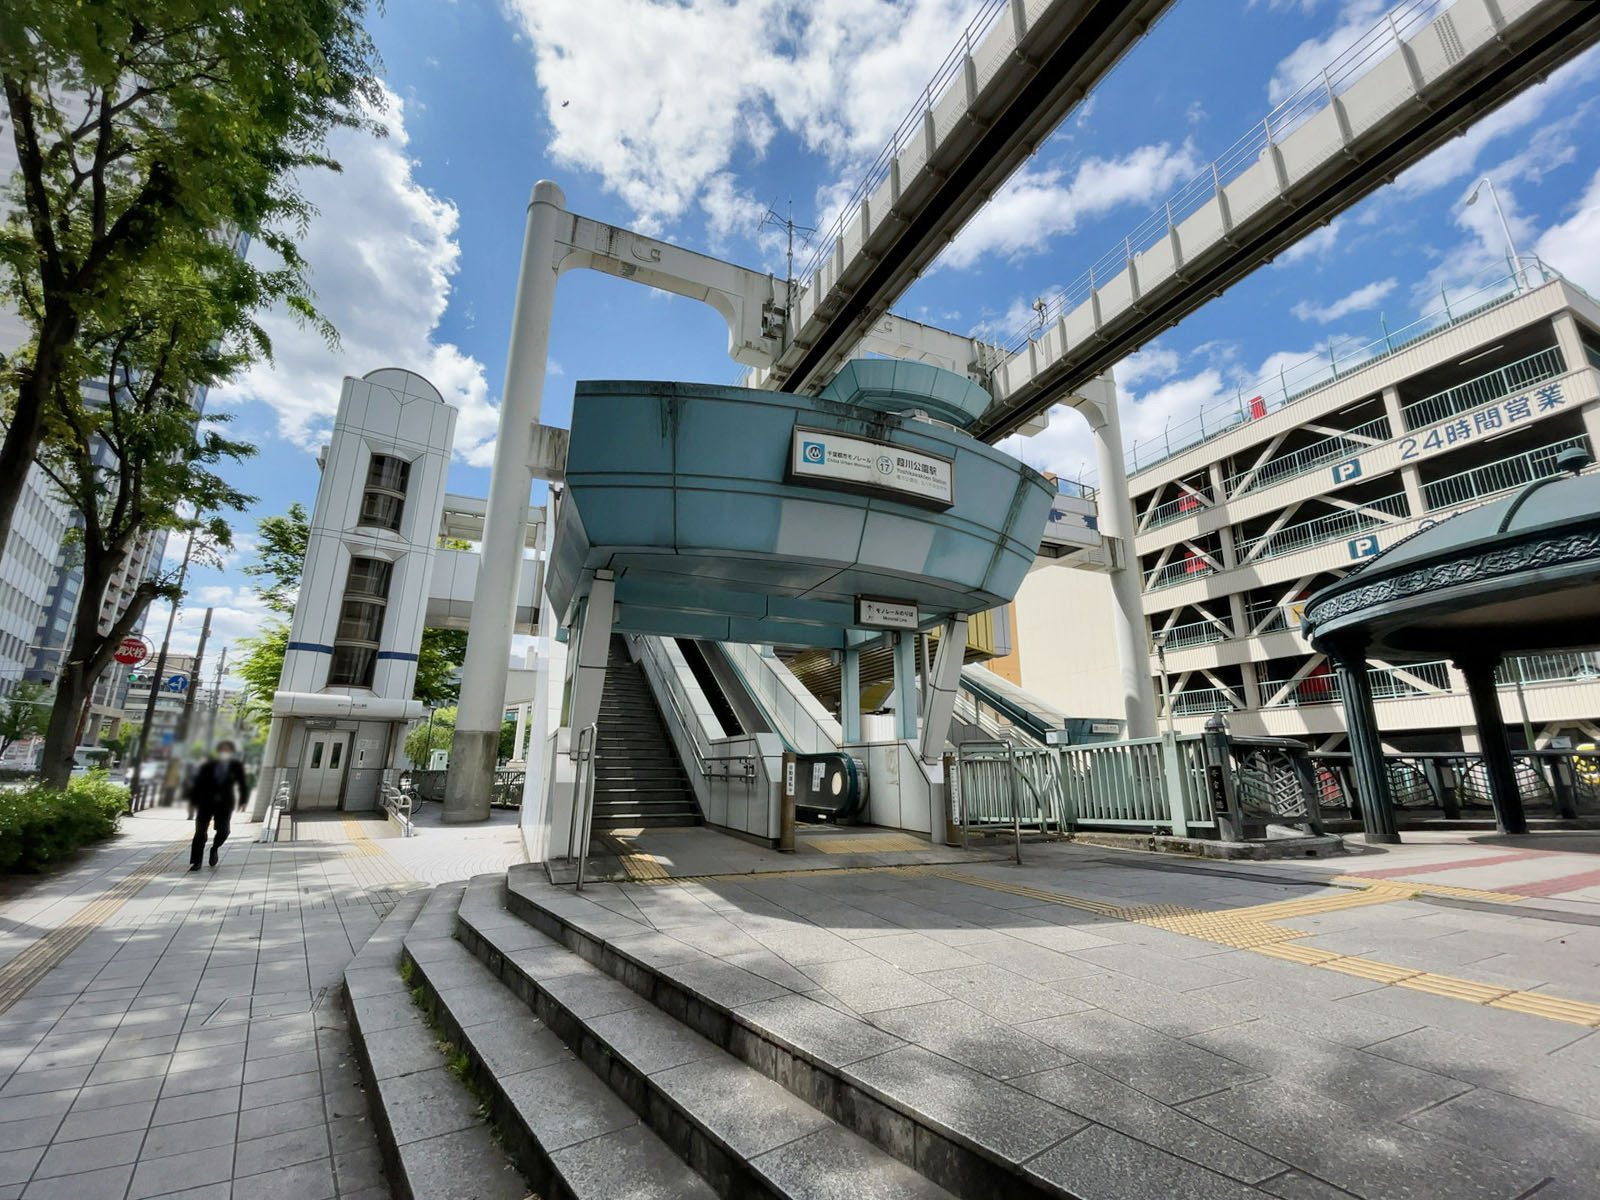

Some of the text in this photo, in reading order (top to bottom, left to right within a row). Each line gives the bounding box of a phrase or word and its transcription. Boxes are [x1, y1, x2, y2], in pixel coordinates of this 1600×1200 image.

[1398, 383, 1566, 461] 24時間営業
[879, 463, 890, 472] 17
[1339, 463, 1355, 482] P
[1356, 539, 1371, 557] P
